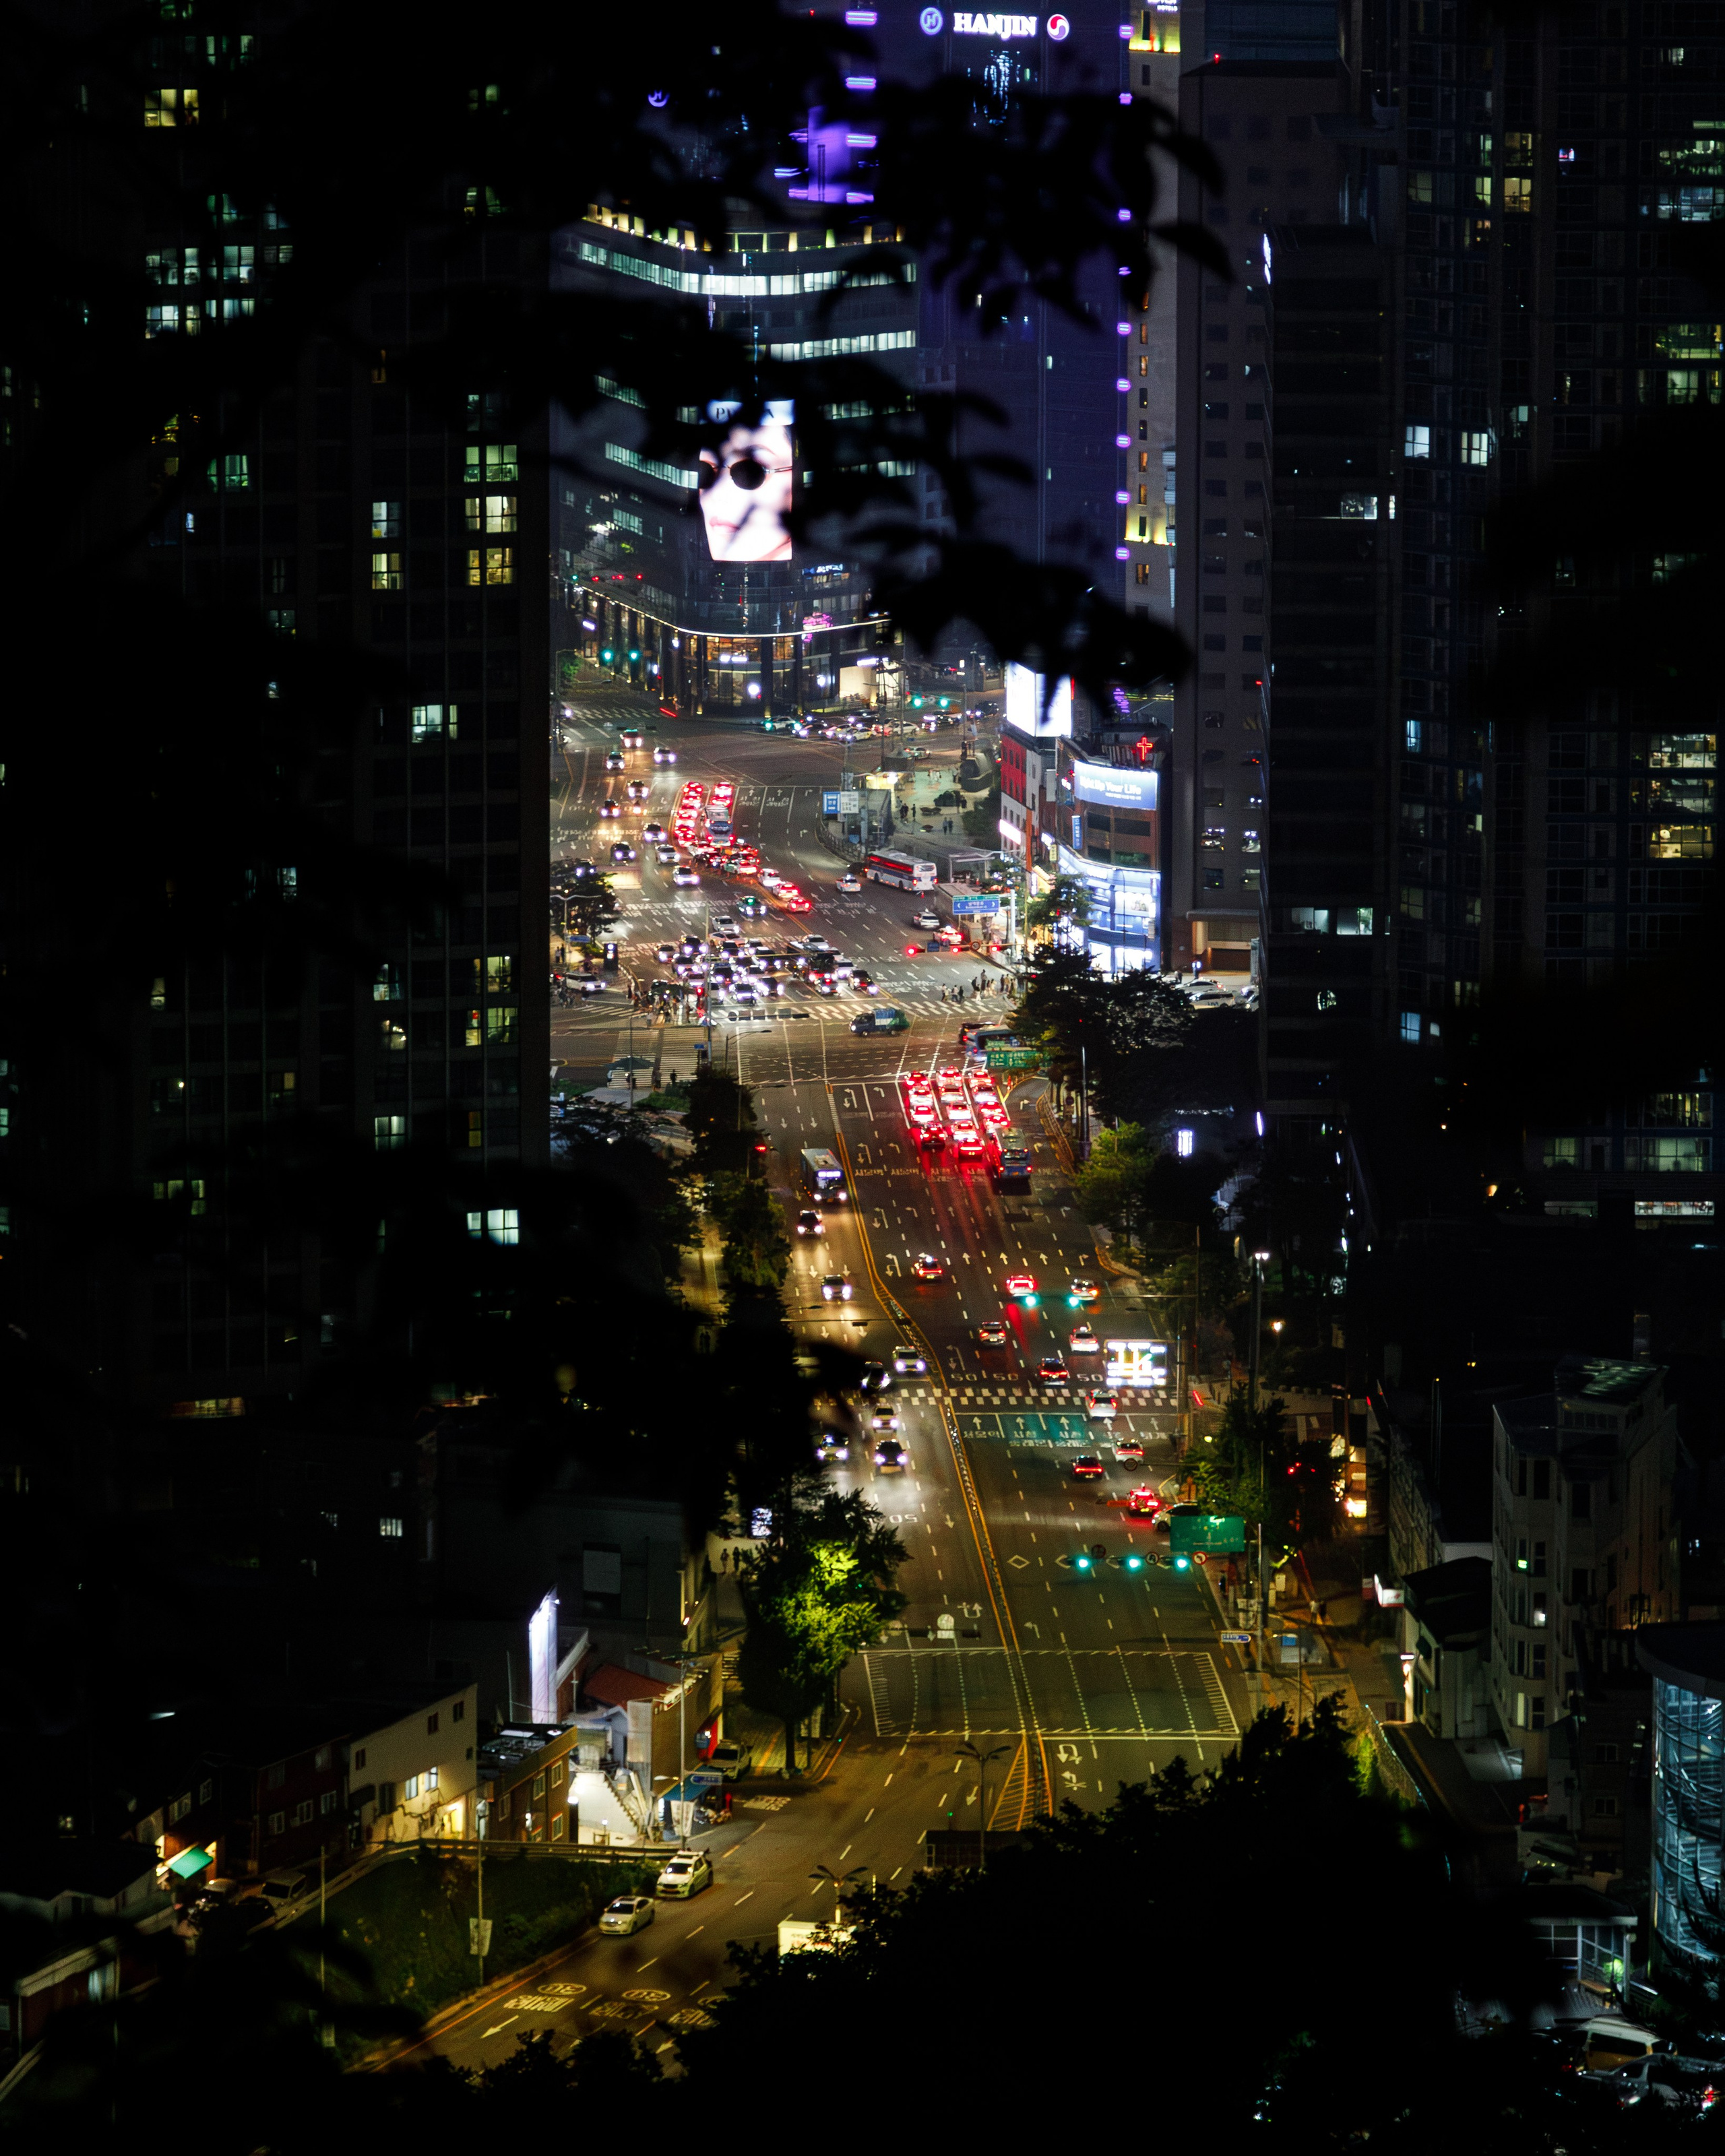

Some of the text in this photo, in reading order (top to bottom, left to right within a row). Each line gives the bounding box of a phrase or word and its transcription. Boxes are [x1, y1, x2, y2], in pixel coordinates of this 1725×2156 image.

[953, 12, 1037, 40] HANJIN
[1105, 781, 1124, 793] Your
[1124, 784, 1142, 795] Life
[993, 1373, 1019, 1381] 50
[1077, 1374, 1104, 1382] 50
[889, 1514, 918, 1523] 50
